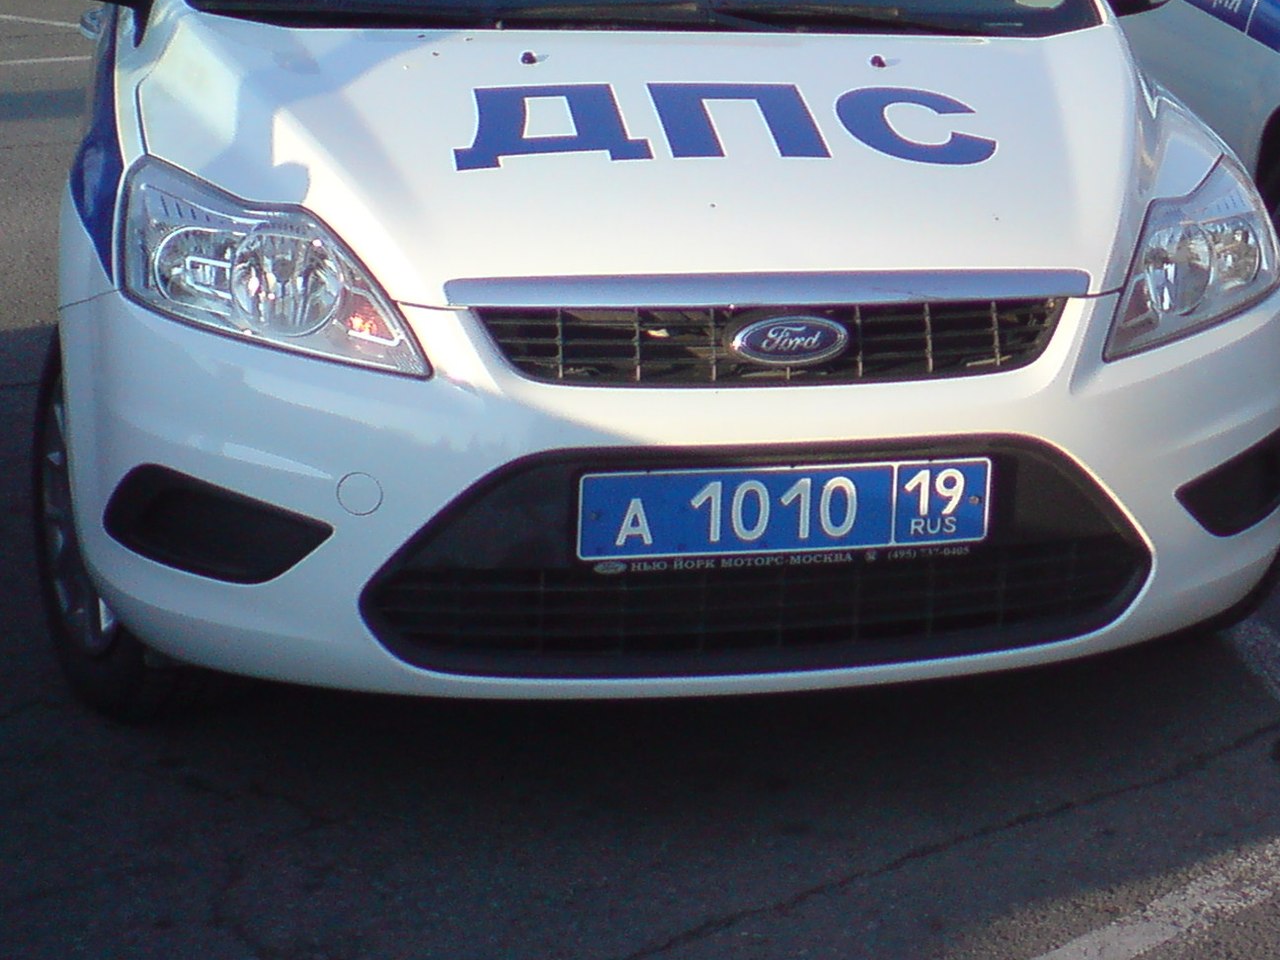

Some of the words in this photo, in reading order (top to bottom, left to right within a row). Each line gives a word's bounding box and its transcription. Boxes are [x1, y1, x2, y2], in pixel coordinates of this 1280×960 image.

[451, 82, 998, 172] ДПС
[761, 326, 822, 351] Ford
[615, 497, 653, 546] А
[691, 476, 857, 542] 1010
[904, 468, 965, 516] 19
[910, 517, 957, 535] RUS
